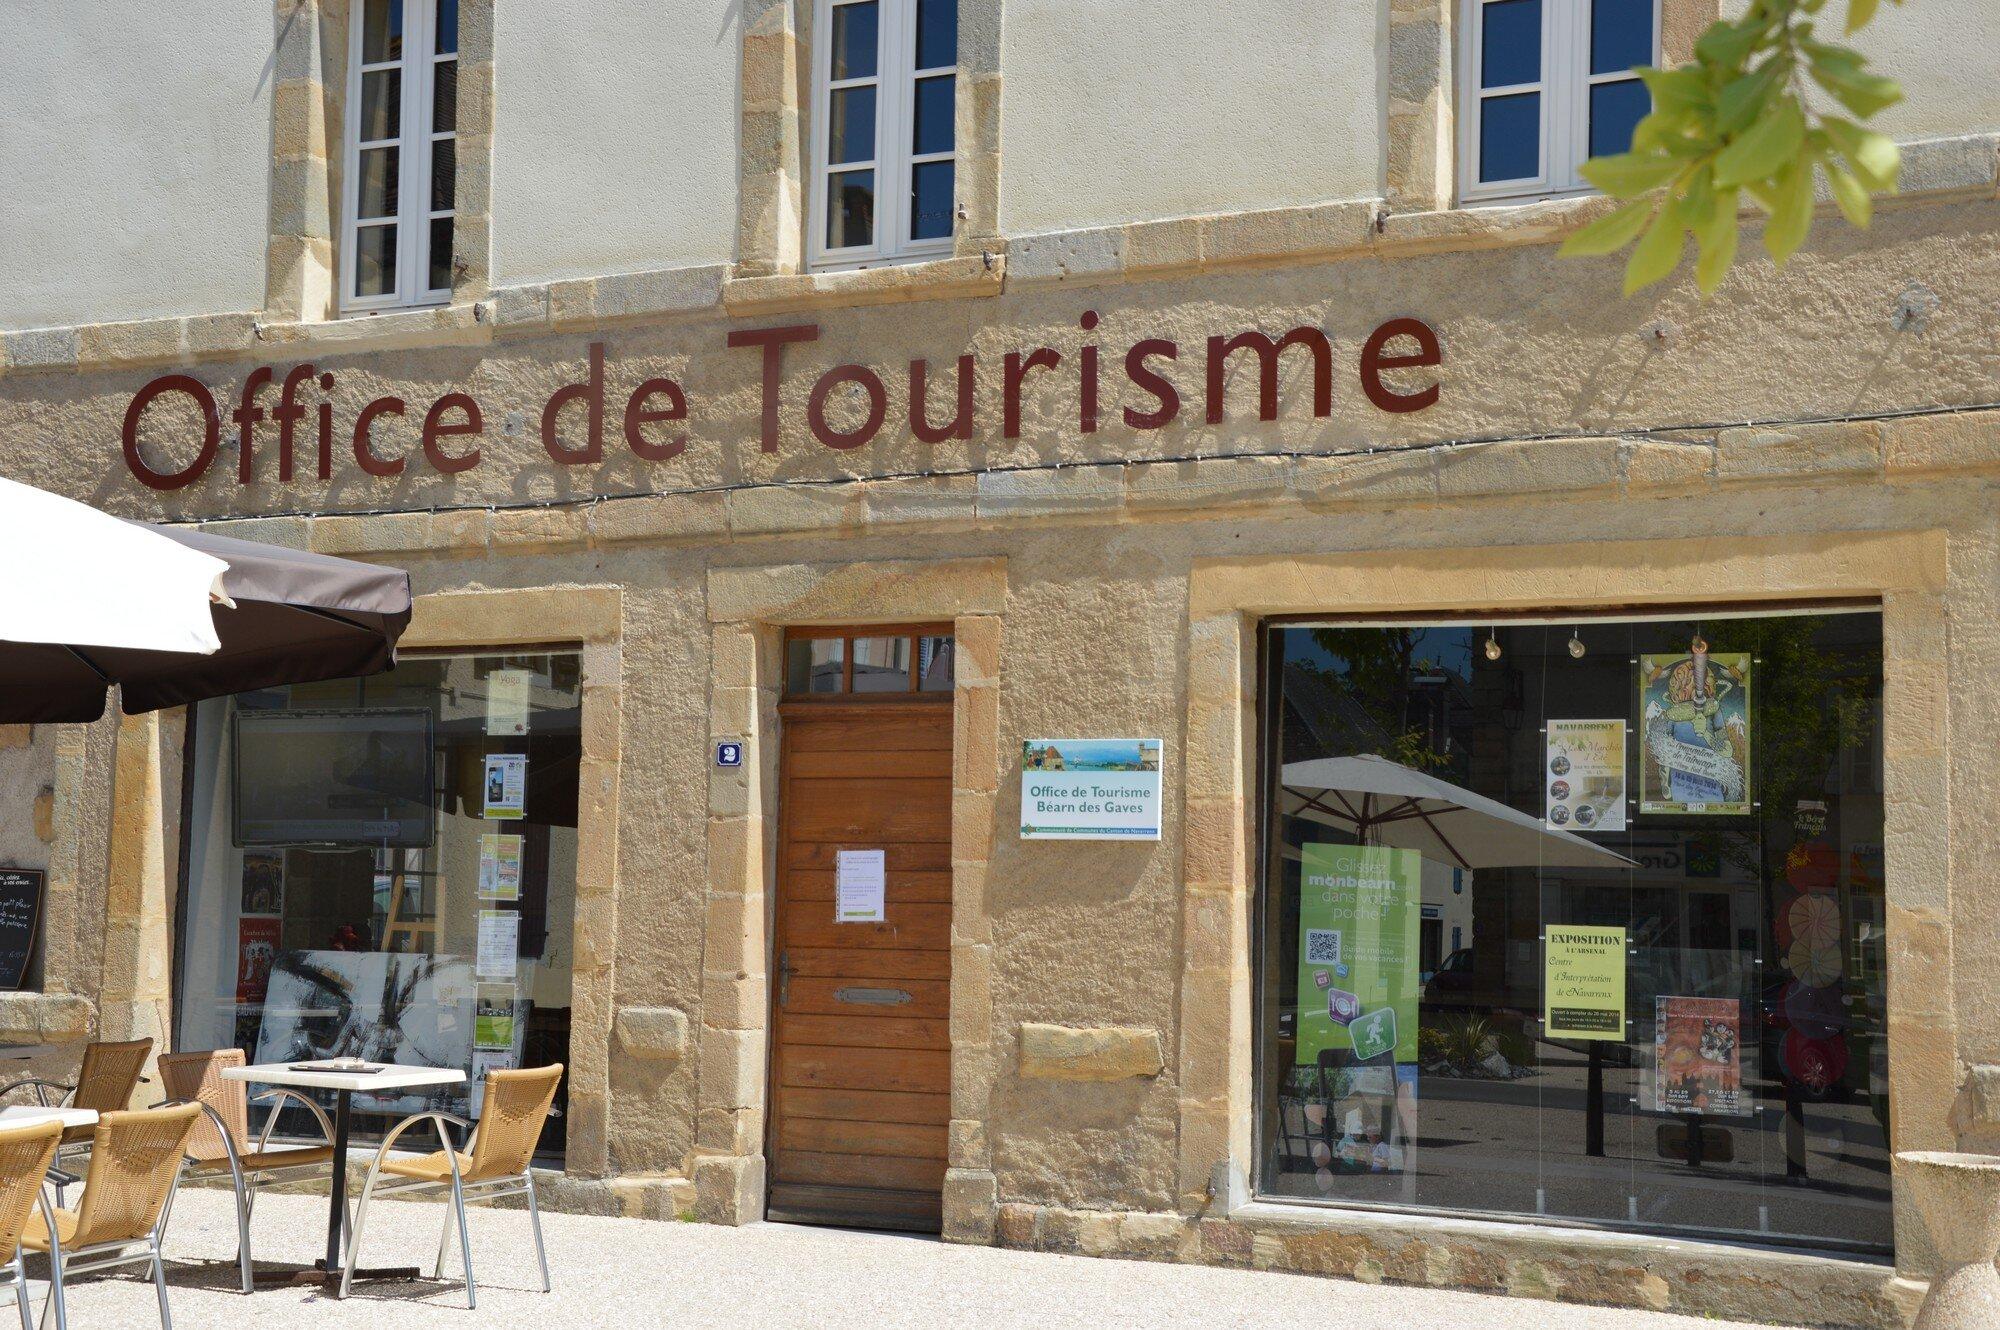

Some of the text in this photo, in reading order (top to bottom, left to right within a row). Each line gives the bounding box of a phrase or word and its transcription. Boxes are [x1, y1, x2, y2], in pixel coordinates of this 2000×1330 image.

[122, 310, 1442, 491] Office de Tourisme
[500, 674, 521, 687] Yoga
[1556, 723, 1615, 731] NAVARRENX
[723, 746, 735, 762] 2
[1030, 786, 1151, 798] Office de Tourisme
[1037, 801, 1143, 813] Béarn des Gaves
[1336, 857, 1386, 874] Glissez
[1321, 889, 1400, 907] dans votre
[1333, 905, 1379, 922] poche
[1551, 934, 1621, 945] EXPOSITION
[1571, 947, 1607, 955] L'ARSENAL
[1549, 956, 1573, 966] Centre
[1554, 971, 1612, 983] d'Interprétation
[1556, 988, 1613, 998] de Navarrenx
